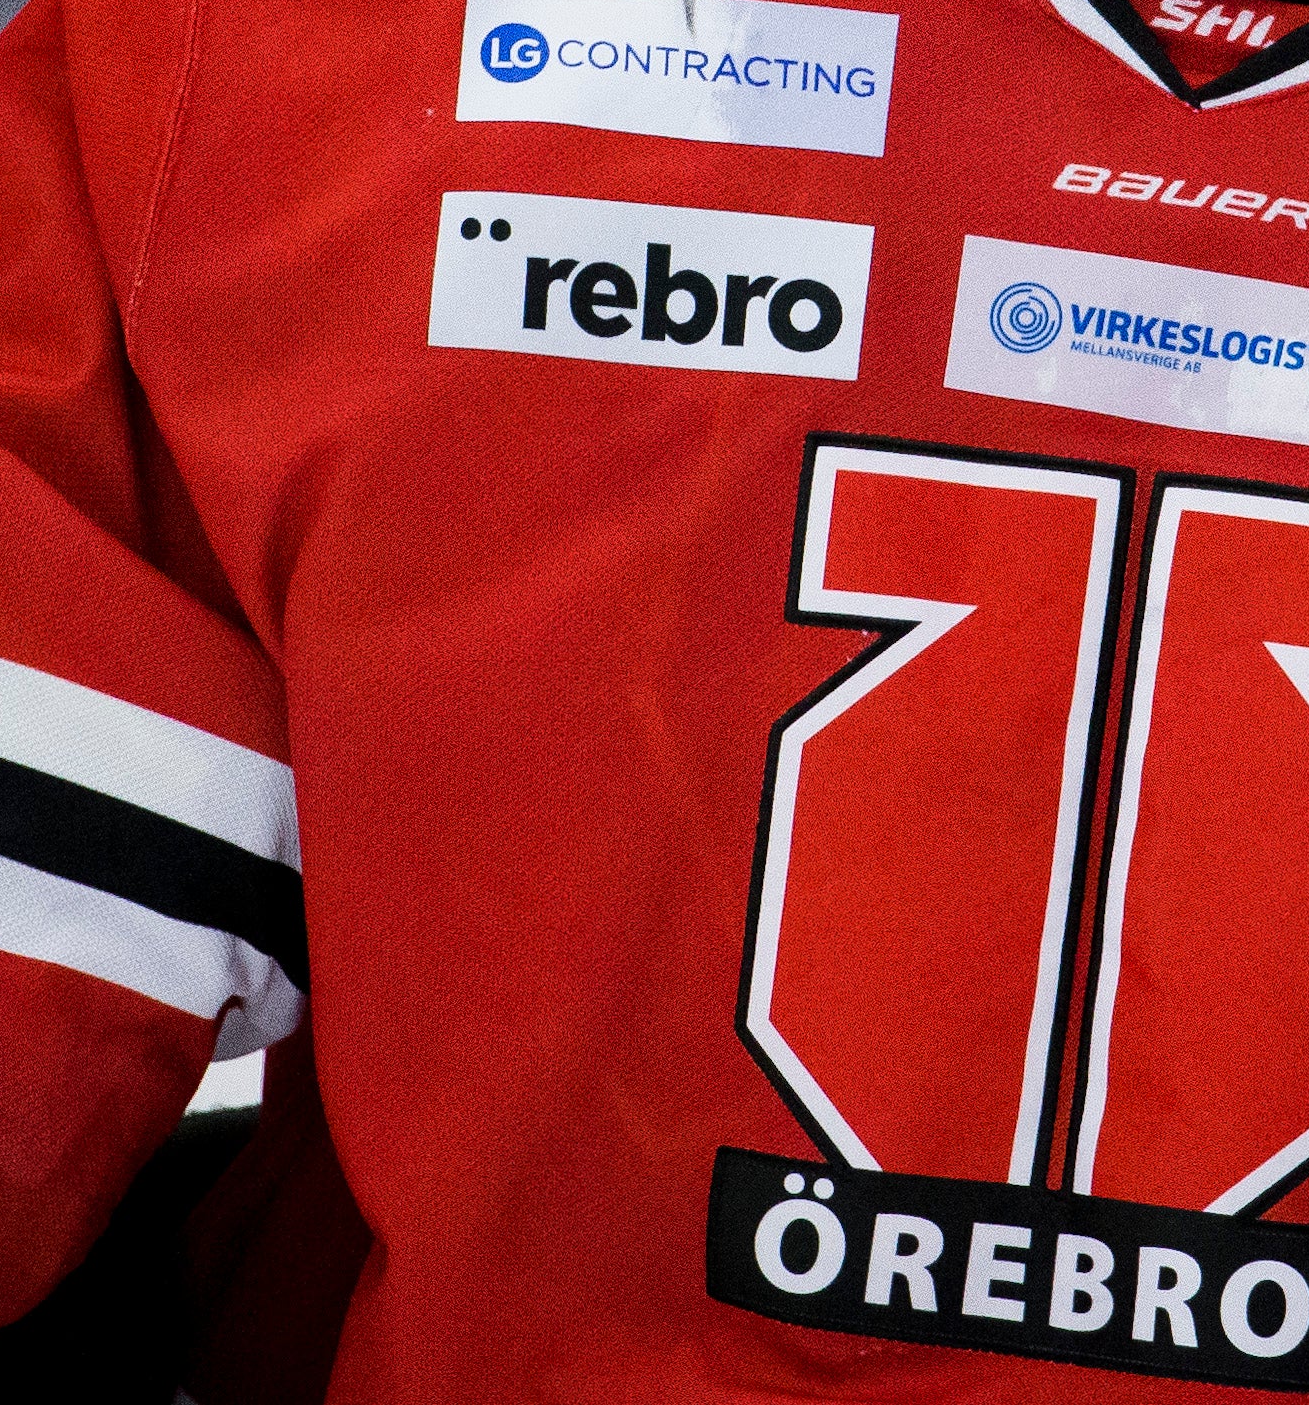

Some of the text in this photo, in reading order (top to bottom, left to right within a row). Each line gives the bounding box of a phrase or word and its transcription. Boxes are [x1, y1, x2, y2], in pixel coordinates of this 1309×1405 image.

[490, 35, 877, 98] LG CONTRACTING
[1070, 340, 1203, 374] MELLANSVERIGE AB
